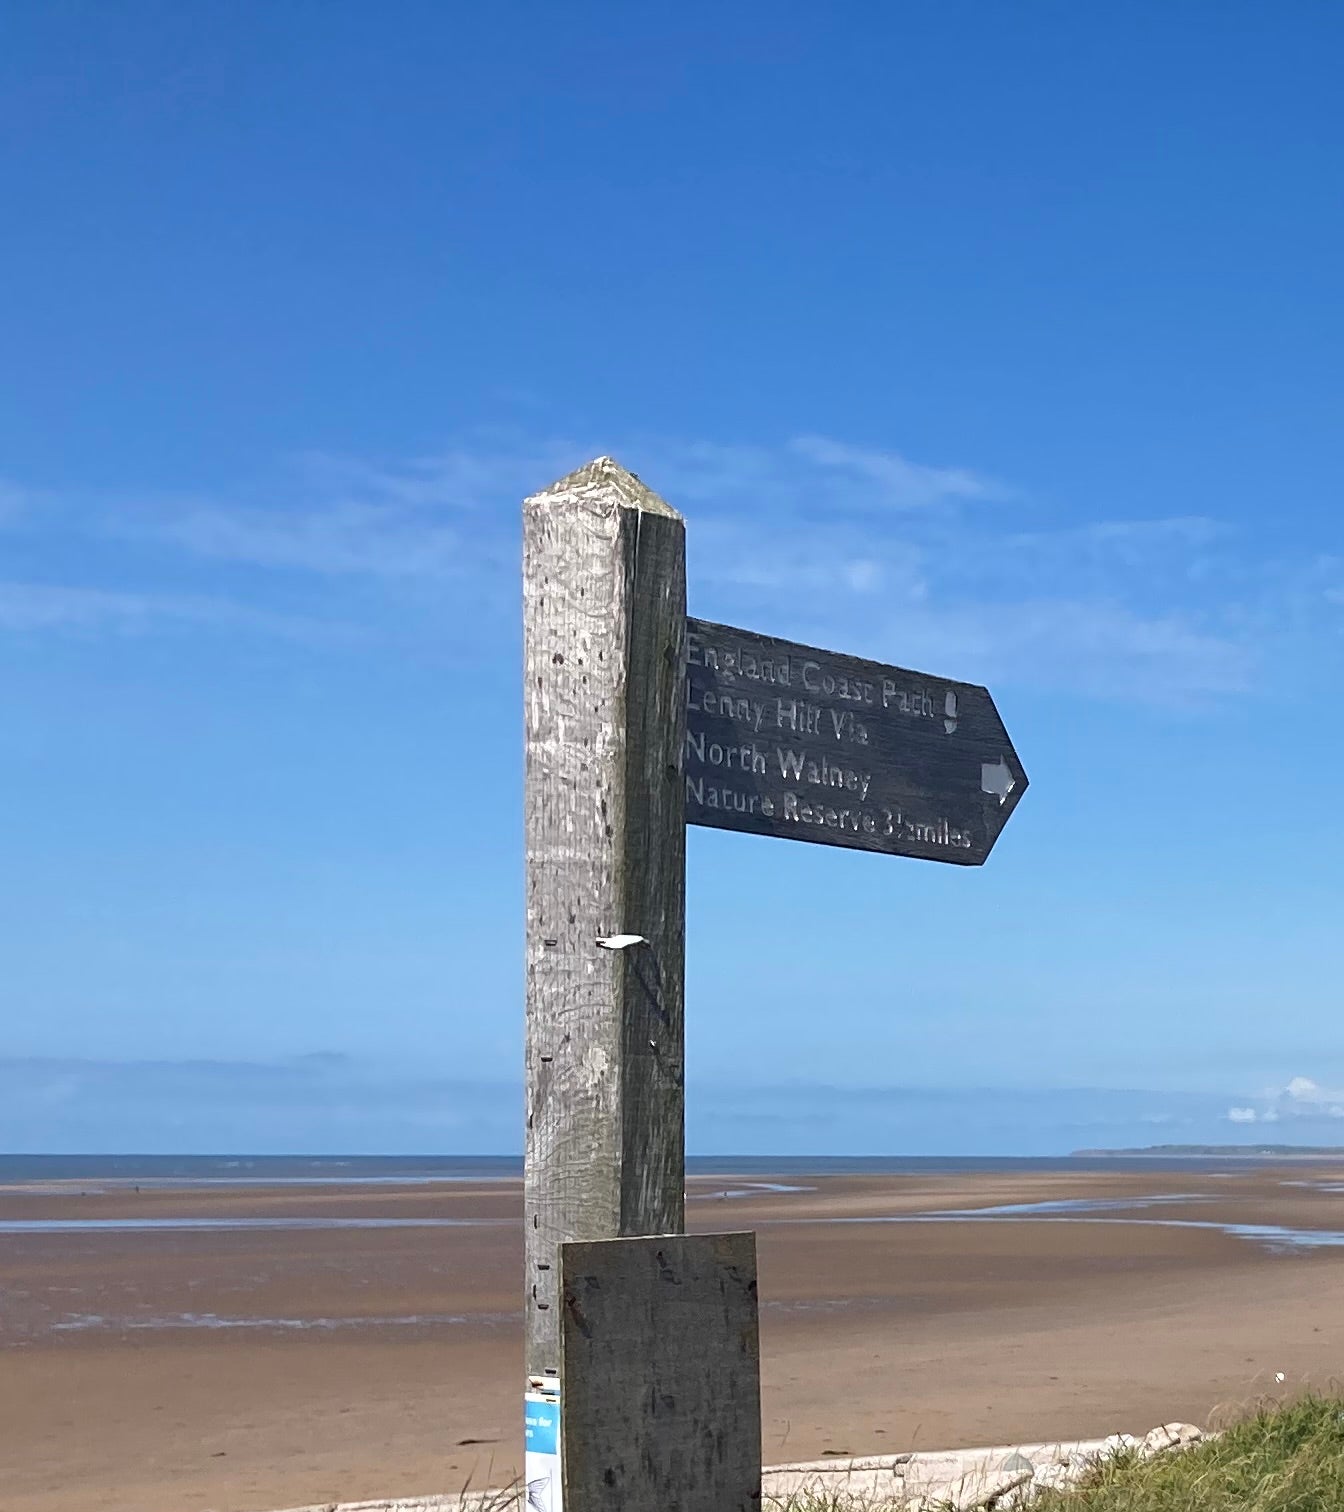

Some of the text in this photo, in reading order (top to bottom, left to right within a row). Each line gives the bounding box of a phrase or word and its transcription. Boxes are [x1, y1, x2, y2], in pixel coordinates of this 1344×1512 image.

[687, 632, 934, 718] England Coast Path
[687, 678, 869, 745] Lenny Hill Via
[686, 729, 871, 801] North Walney
[686, 775, 775, 817] Nature
[784, 791, 875, 833] Reserve
